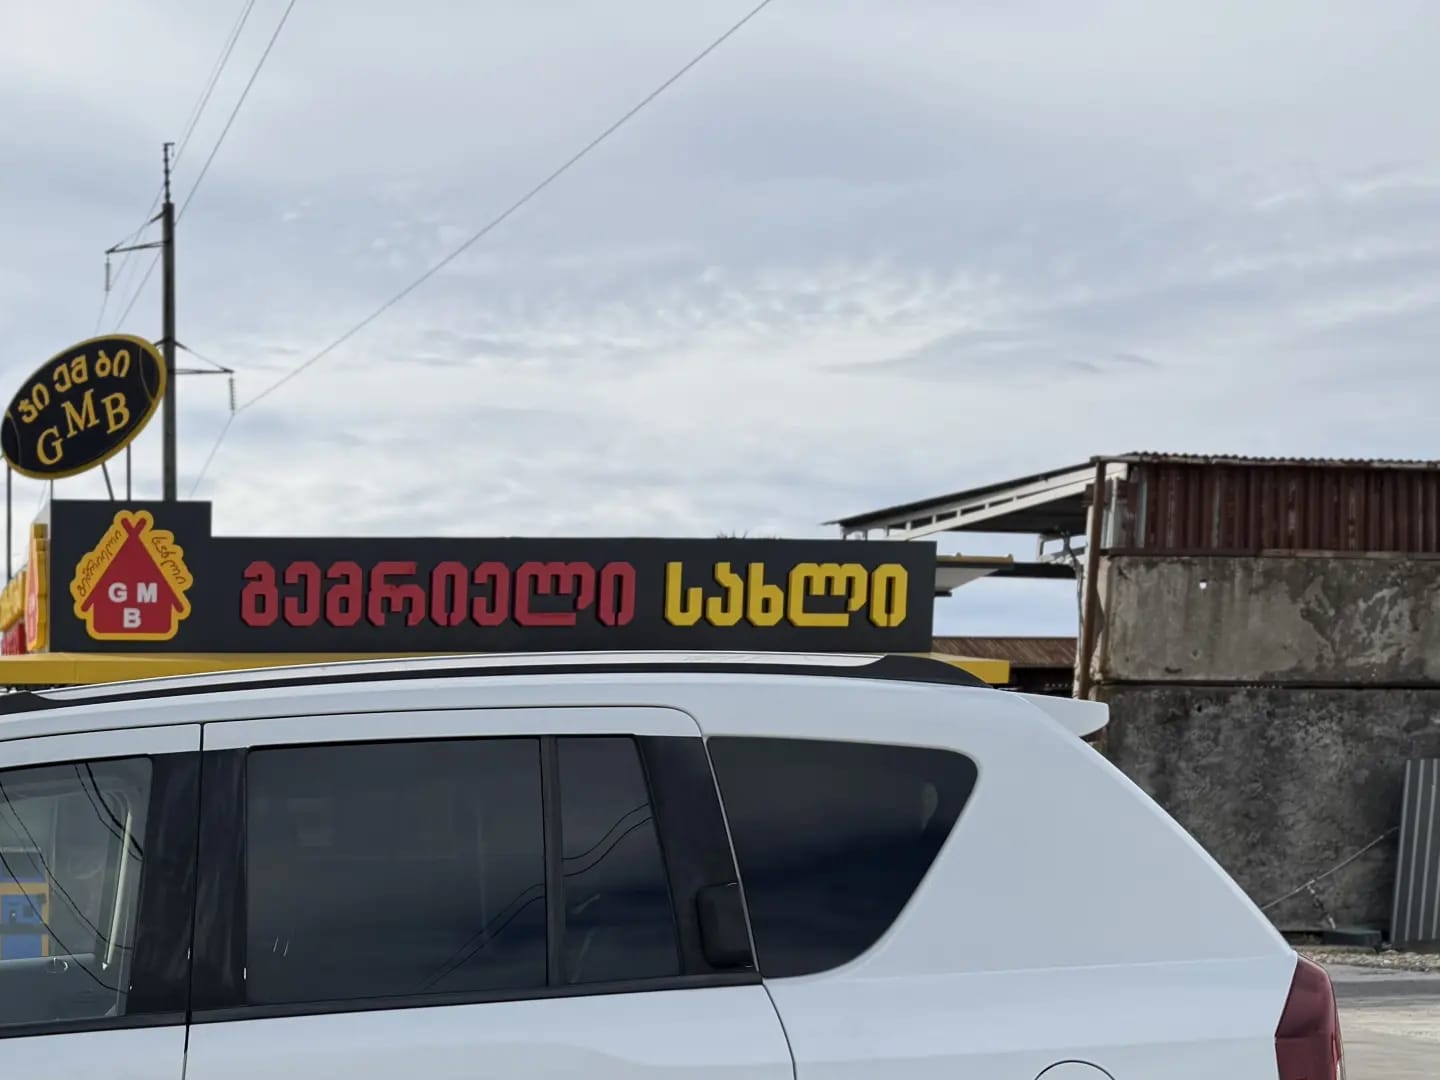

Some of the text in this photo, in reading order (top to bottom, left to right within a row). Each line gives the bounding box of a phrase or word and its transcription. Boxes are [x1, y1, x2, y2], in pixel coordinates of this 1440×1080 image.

[53, 354, 88, 392] ემ
[94, 349, 131, 378] ბი
[36, 388, 130, 465] GMB
[240, 560, 908, 627] გემრიელი სახლი
